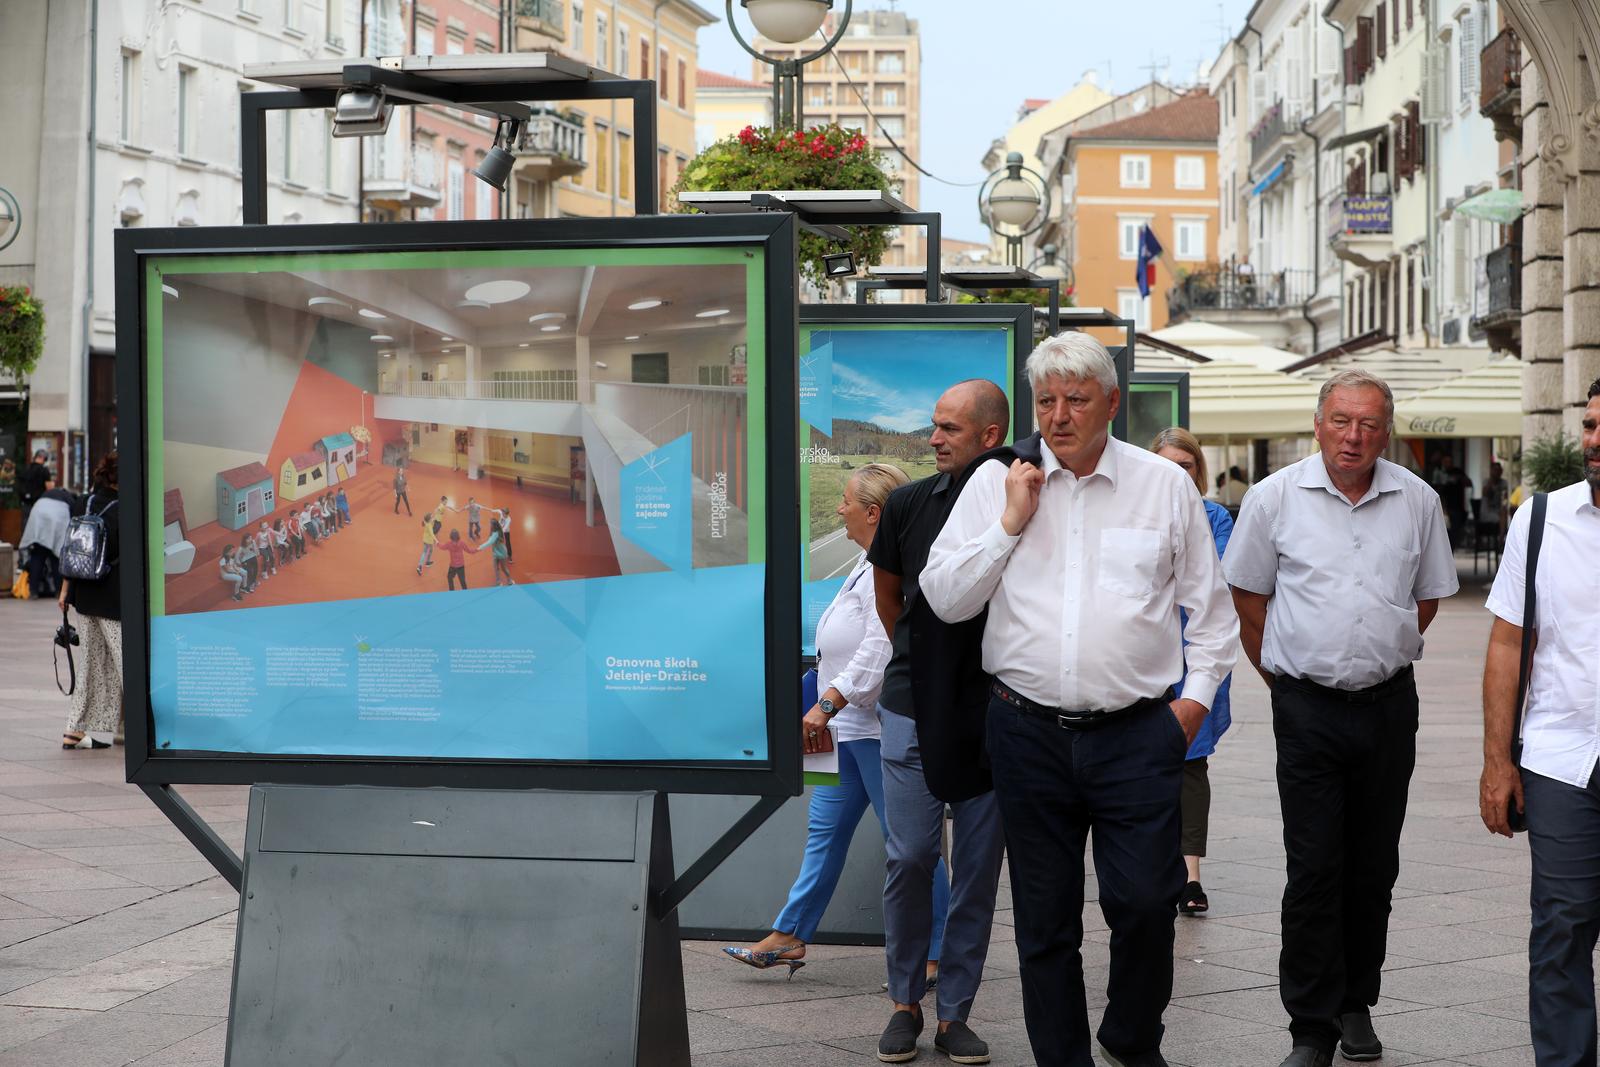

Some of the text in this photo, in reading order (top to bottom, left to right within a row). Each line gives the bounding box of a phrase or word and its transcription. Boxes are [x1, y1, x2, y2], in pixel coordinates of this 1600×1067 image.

[1349, 200, 1388, 211] HAPPY
[1344, 212, 1388, 222] HOSTEL
[715, 472, 731, 520] goranska
[635, 510, 668, 519] zajedno
[707, 482, 722, 538] primorsko
[605, 656, 699, 668] Osnovna škola
[605, 670, 707, 684] Jelenje-Dražice
